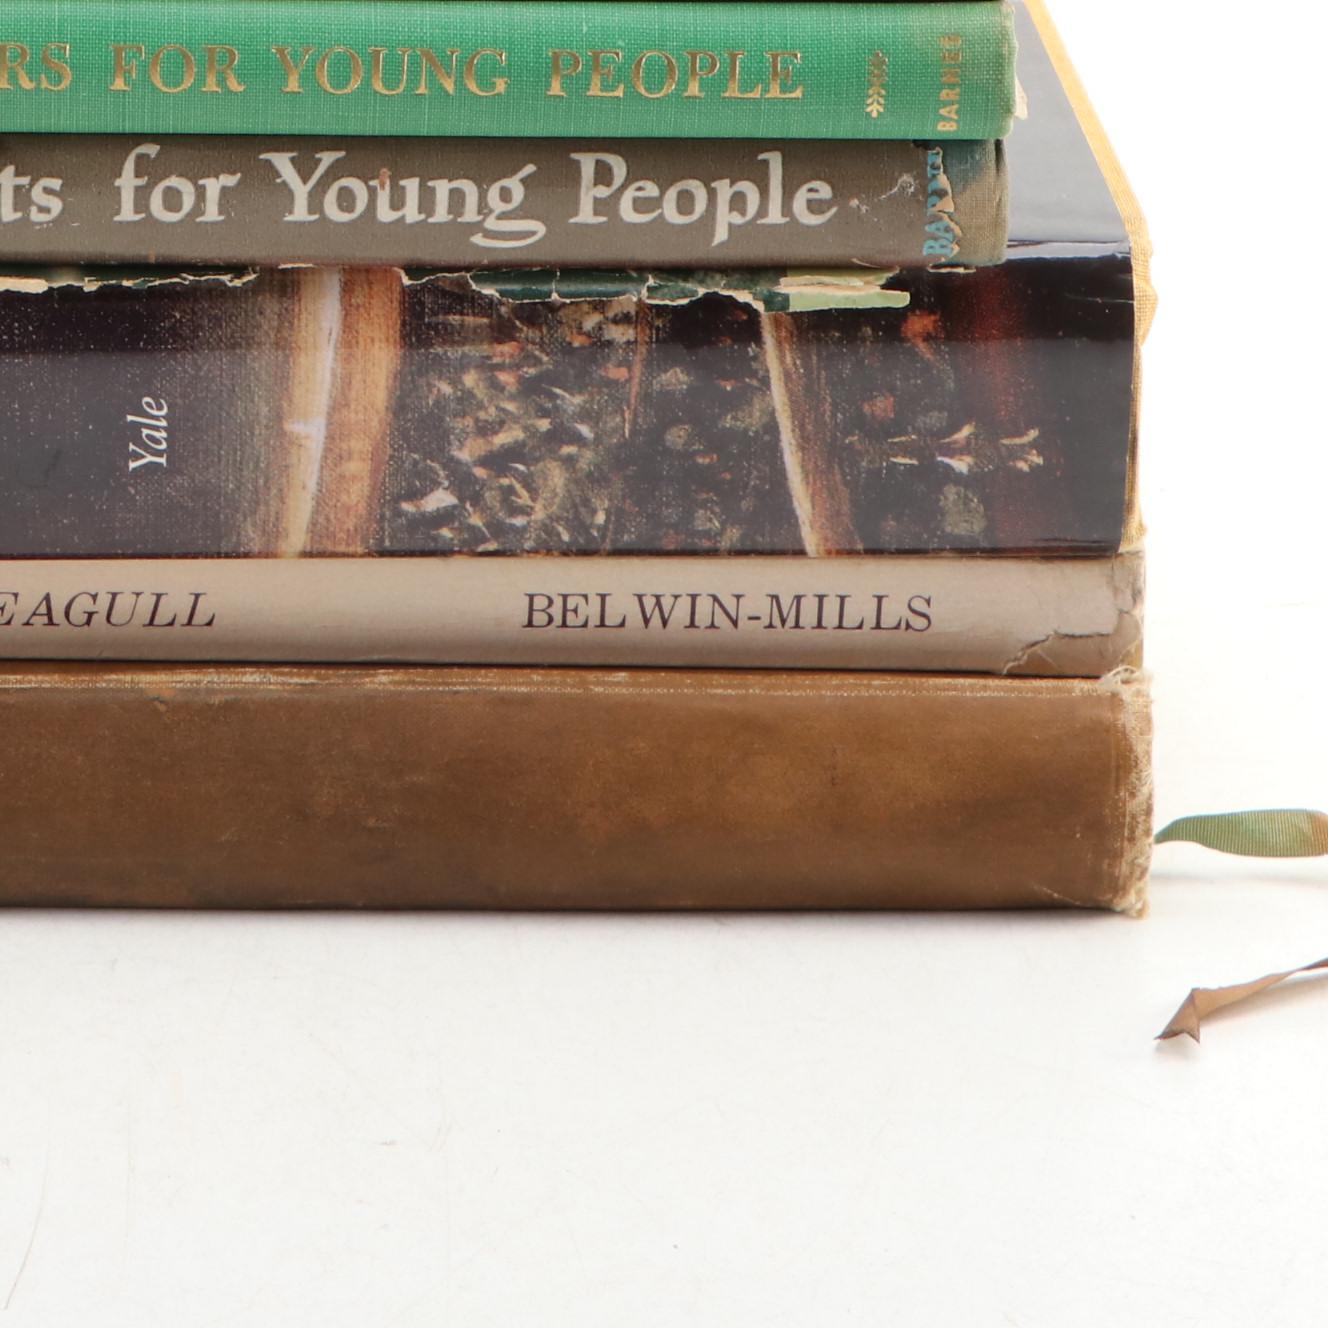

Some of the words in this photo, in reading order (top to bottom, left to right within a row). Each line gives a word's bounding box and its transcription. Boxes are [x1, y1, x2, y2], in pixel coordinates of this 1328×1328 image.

[109, 43, 246, 93] FOR
[273, 45, 508, 97] YOUNG
[547, 49, 802, 100] PEOPLE
[936, 34, 962, 132] BARNES
[114, 143, 241, 223] for
[261, 151, 546, 249] Young
[570, 151, 838, 246] People
[126, 397, 168, 471] Yale
[523, 592, 932, 632] BELWIN-MILLS
